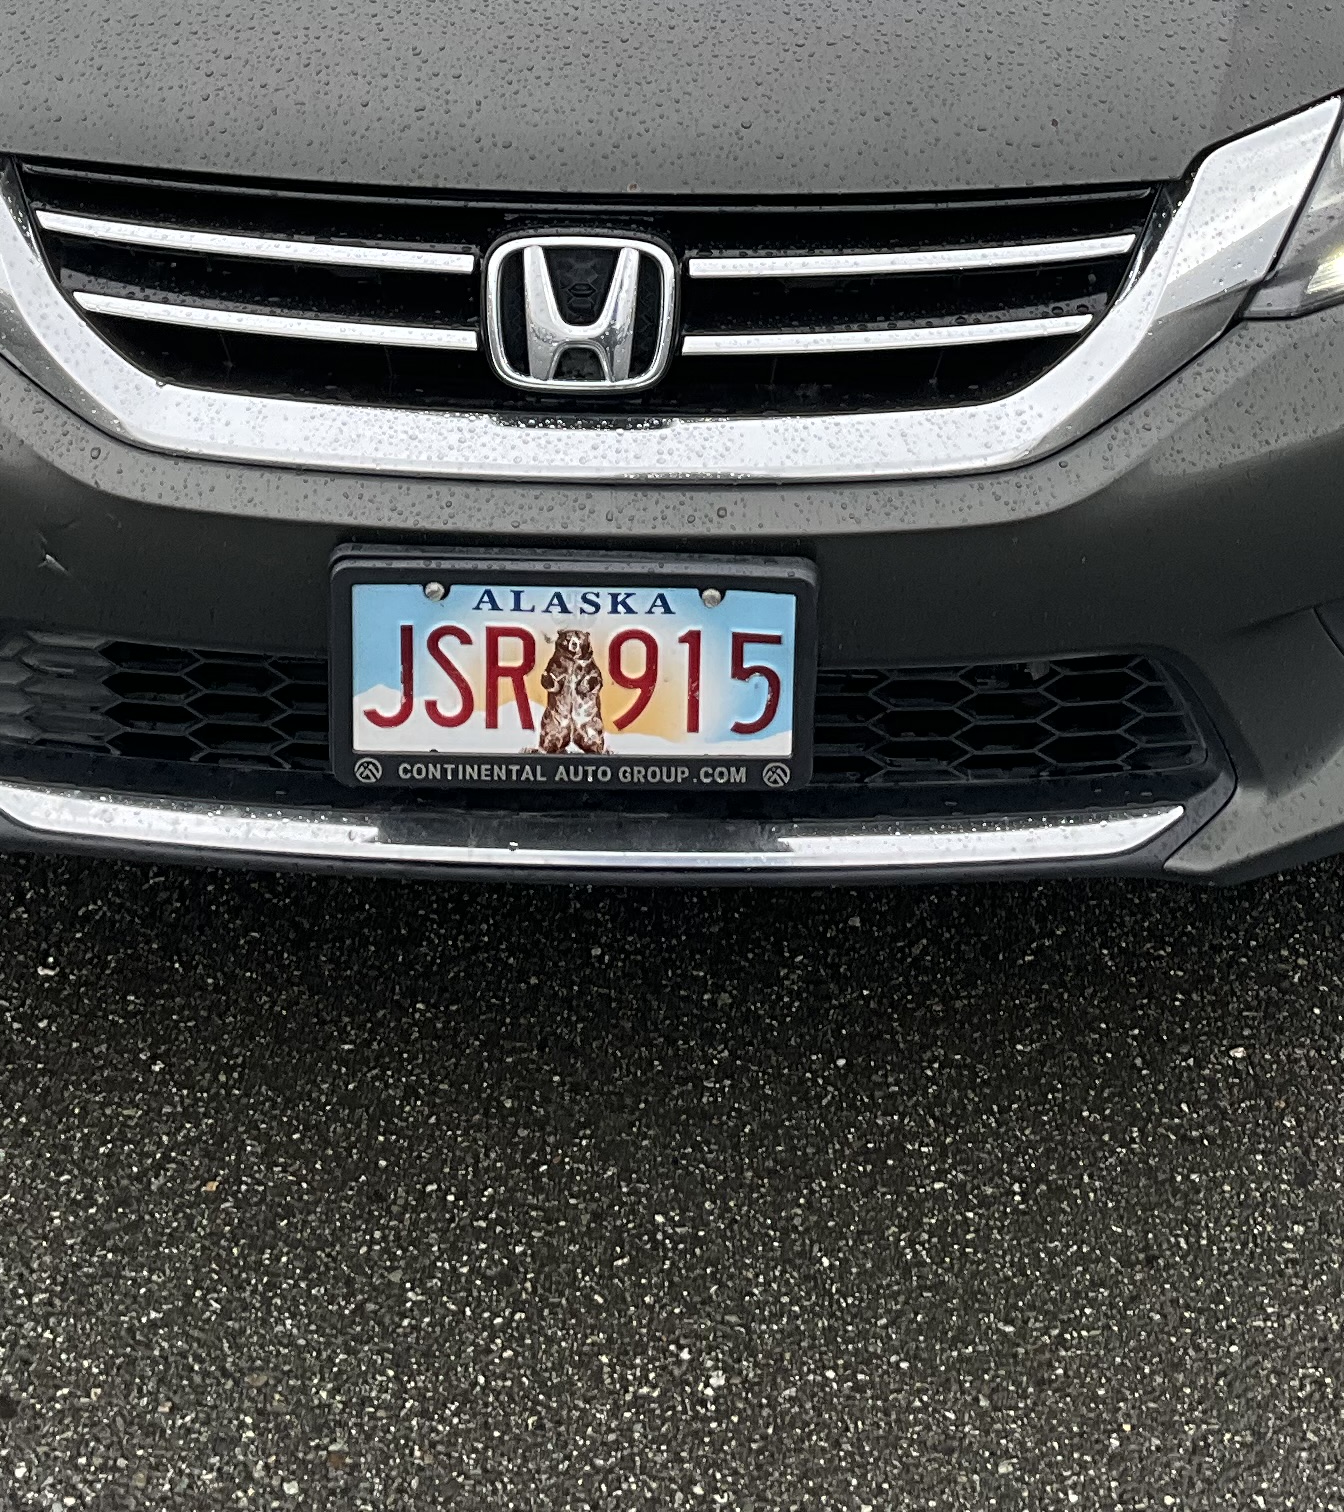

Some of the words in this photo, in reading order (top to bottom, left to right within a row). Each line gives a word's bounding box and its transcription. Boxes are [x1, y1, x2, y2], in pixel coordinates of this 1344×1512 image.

[471, 588, 676, 616] ALASKA
[363, 624, 536, 730] JSR
[608, 628, 782, 735] 915
[398, 762, 547, 782] CONTINENTAL
[554, 764, 612, 782] AUTO
[618, 765, 747, 784] GROUP.COM
